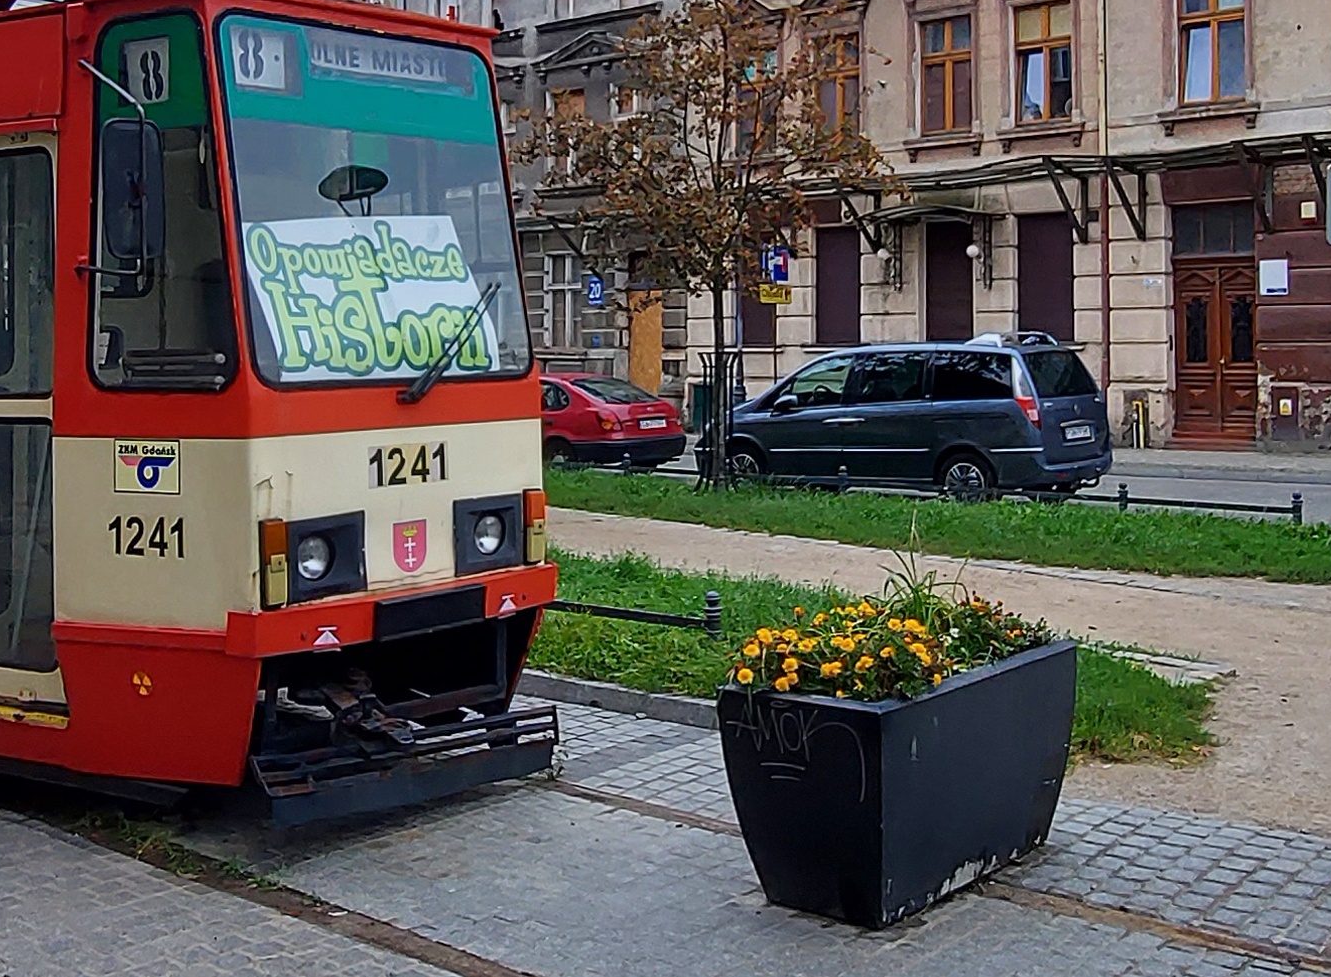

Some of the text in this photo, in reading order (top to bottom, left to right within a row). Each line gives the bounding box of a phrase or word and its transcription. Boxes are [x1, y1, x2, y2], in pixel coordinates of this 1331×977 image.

[139, 50, 164, 101] 8
[239, 29, 265, 80] 8
[246, 220, 469, 295] Opowiadacze
[589, 283, 601, 299] 20
[118, 444, 176, 455] ZKM Gdańsk
[370, 443, 446, 486] 1241
[108, 515, 185, 559] 1241
